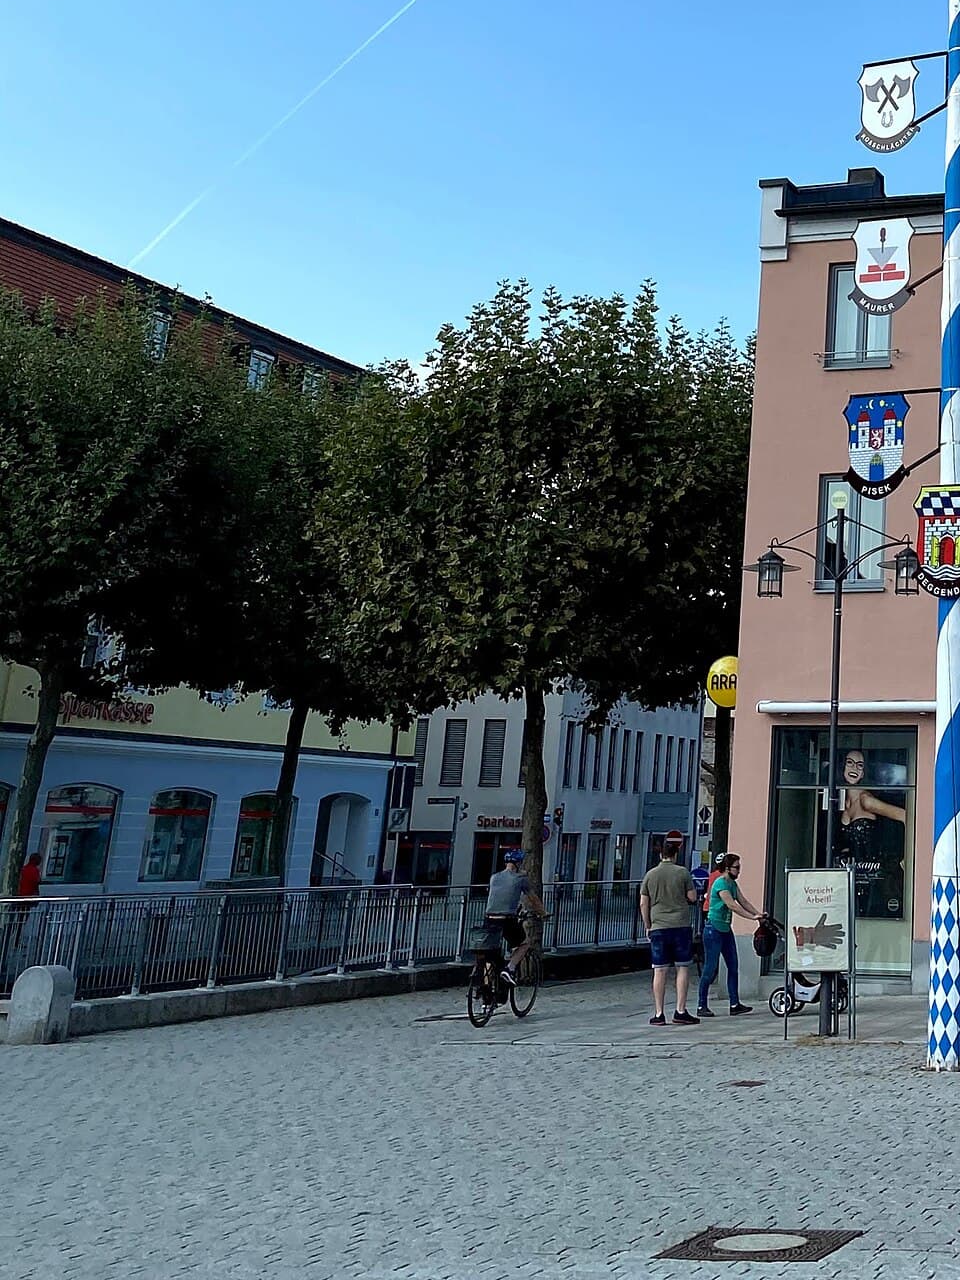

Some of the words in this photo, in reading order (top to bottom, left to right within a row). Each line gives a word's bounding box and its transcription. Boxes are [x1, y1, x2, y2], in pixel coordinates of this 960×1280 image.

[859, 297, 896, 313] MAURER
[861, 483, 893, 496] PISEK
[711, 673, 738, 690] ARA
[803, 886, 833, 895] Vorsicht
